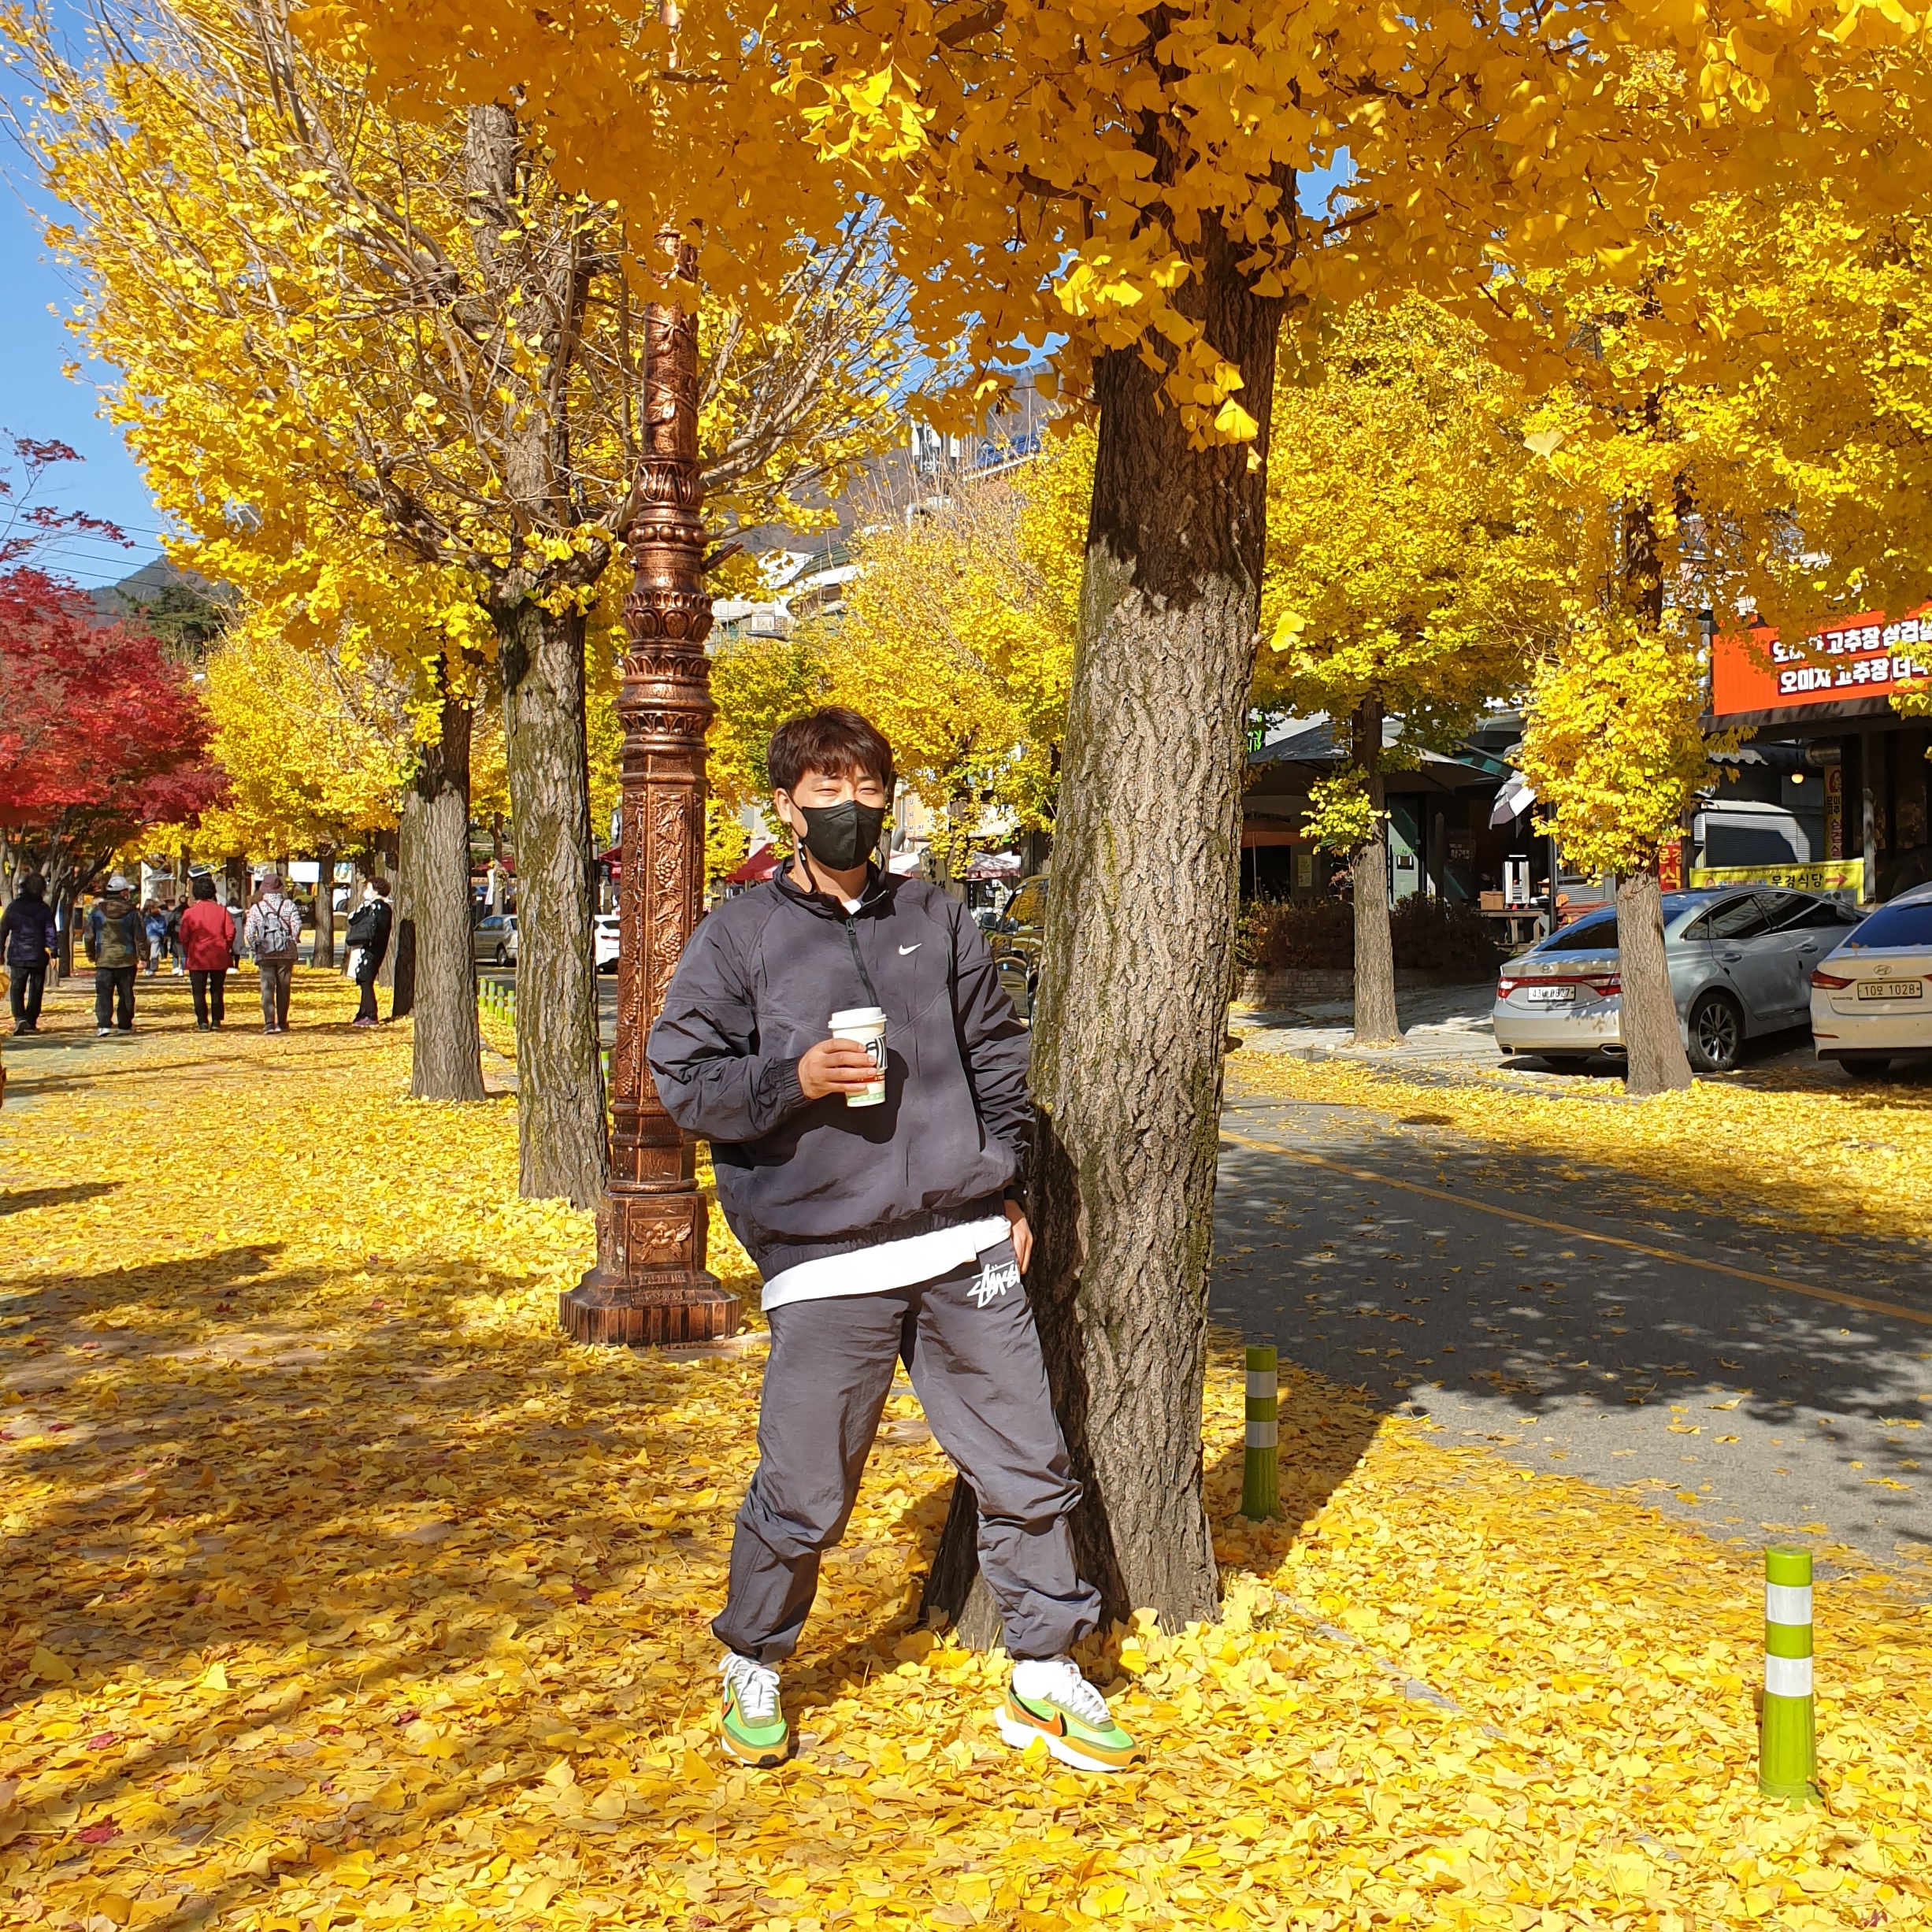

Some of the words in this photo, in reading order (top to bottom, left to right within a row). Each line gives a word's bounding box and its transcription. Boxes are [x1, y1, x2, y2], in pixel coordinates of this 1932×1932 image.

[1826, 626, 1881, 655] 고추장
[1780, 668, 1831, 693] 오미자
[1835, 658, 1889, 687] 고추장
[1864, 985, 1883, 996] 10모
[1889, 984, 1915, 996] 1028
